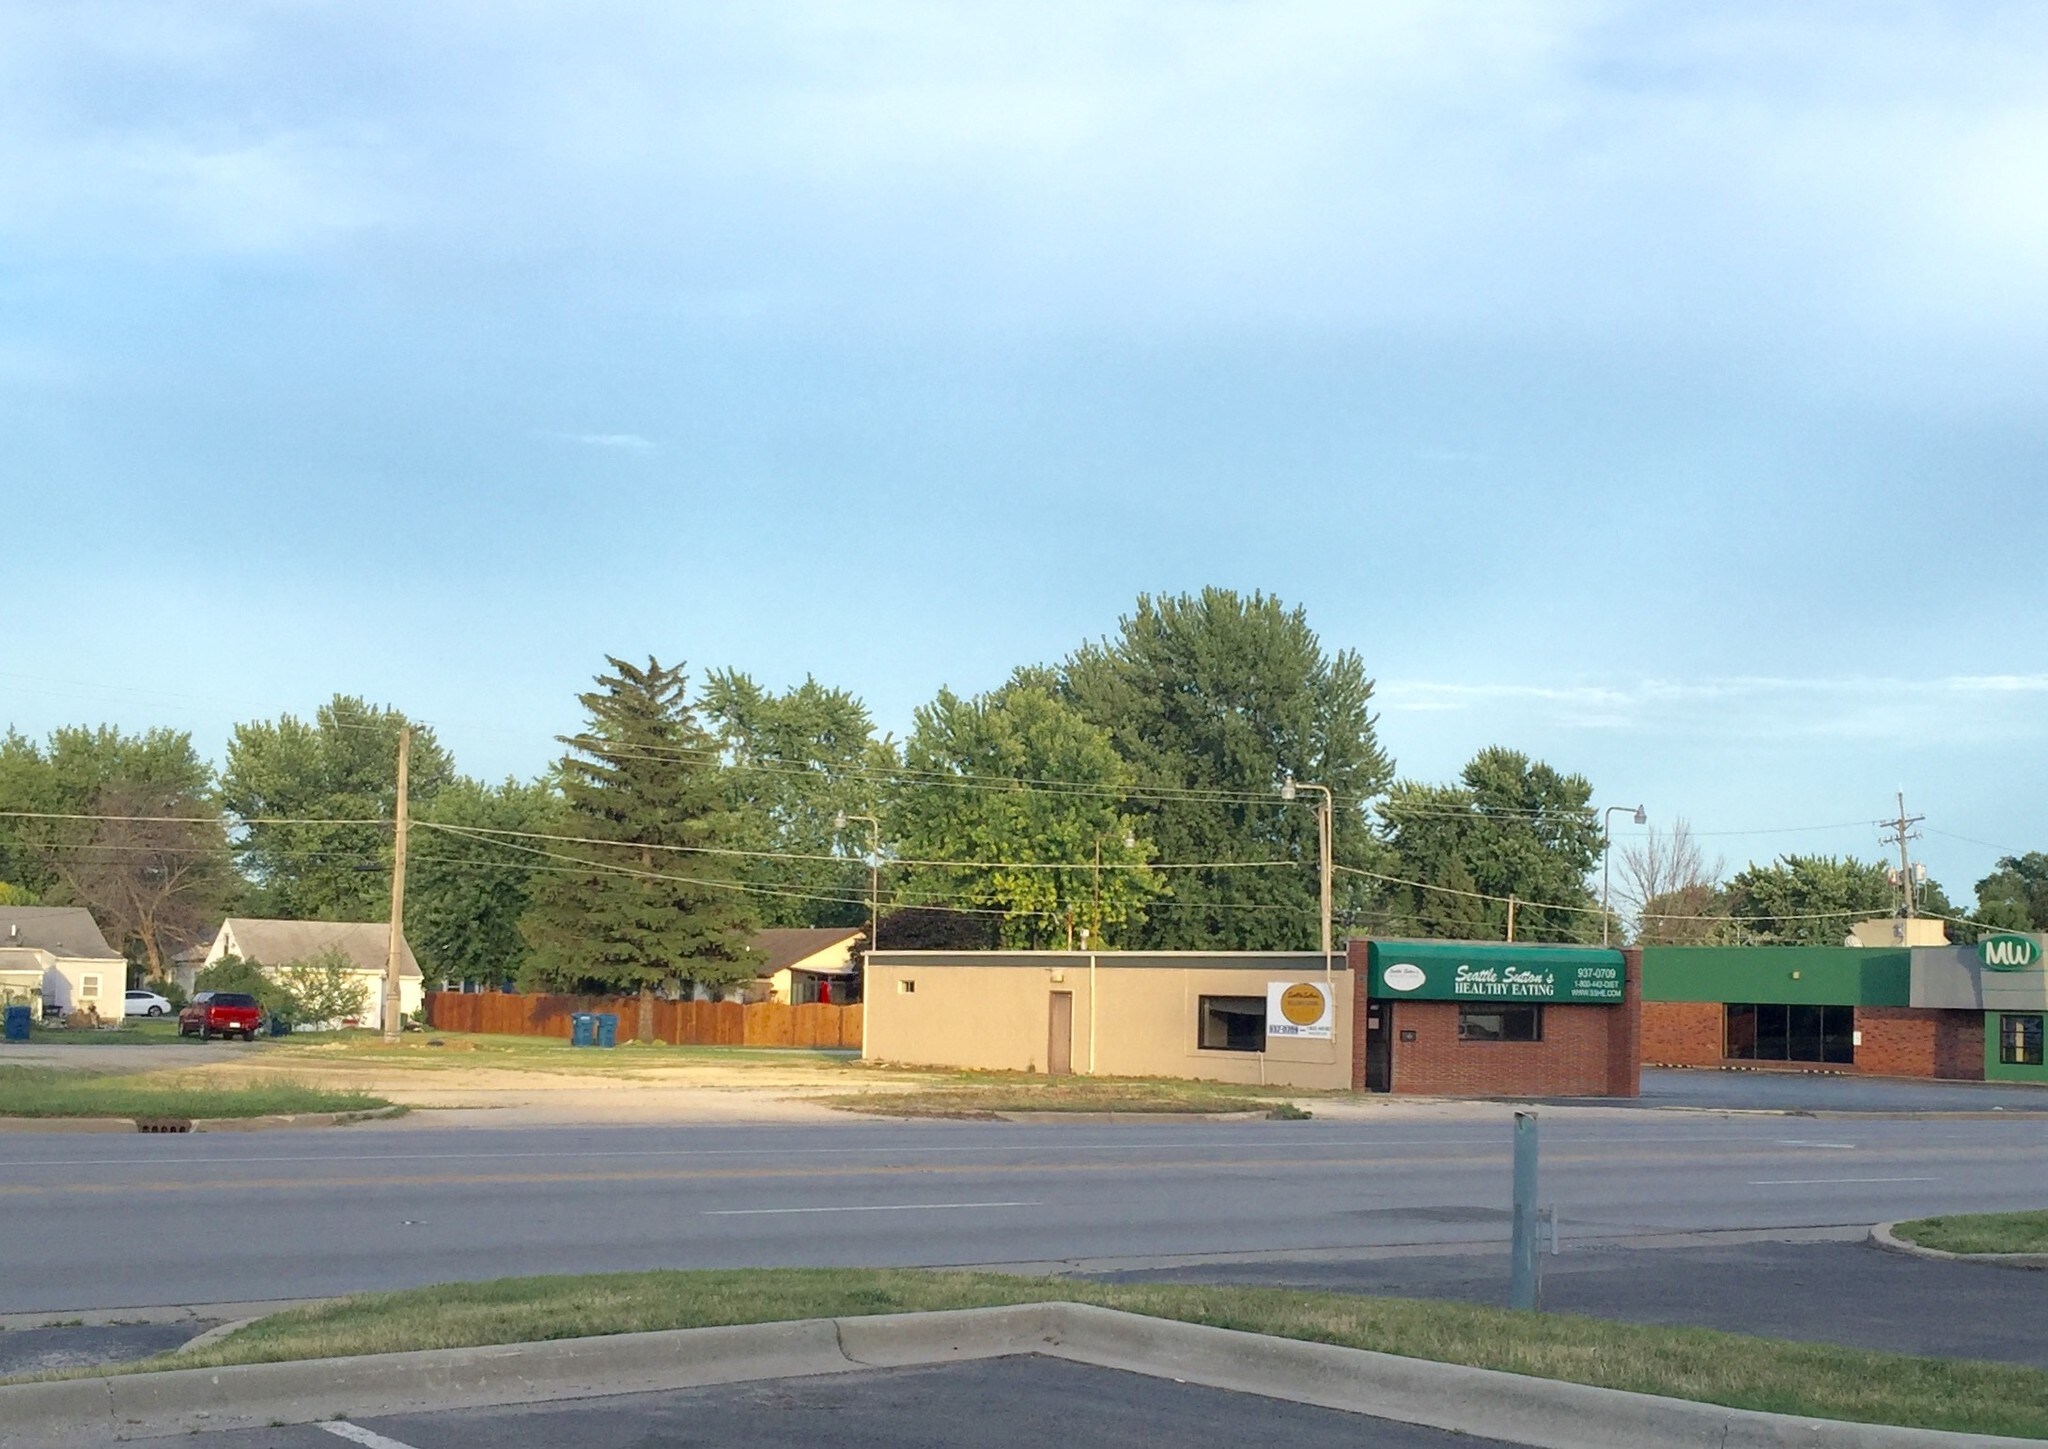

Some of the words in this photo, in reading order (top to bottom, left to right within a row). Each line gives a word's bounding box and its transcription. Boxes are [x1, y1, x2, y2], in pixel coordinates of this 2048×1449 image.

[1986, 941, 2031, 965] MW
[1455, 965, 1498, 982] Seattle
[1502, 966, 1555, 984] Sutton's
[1577, 967, 1616, 979] 937-0709
[1455, 982, 1509, 995] HEALTHY
[1512, 983, 1554, 996] EATING
